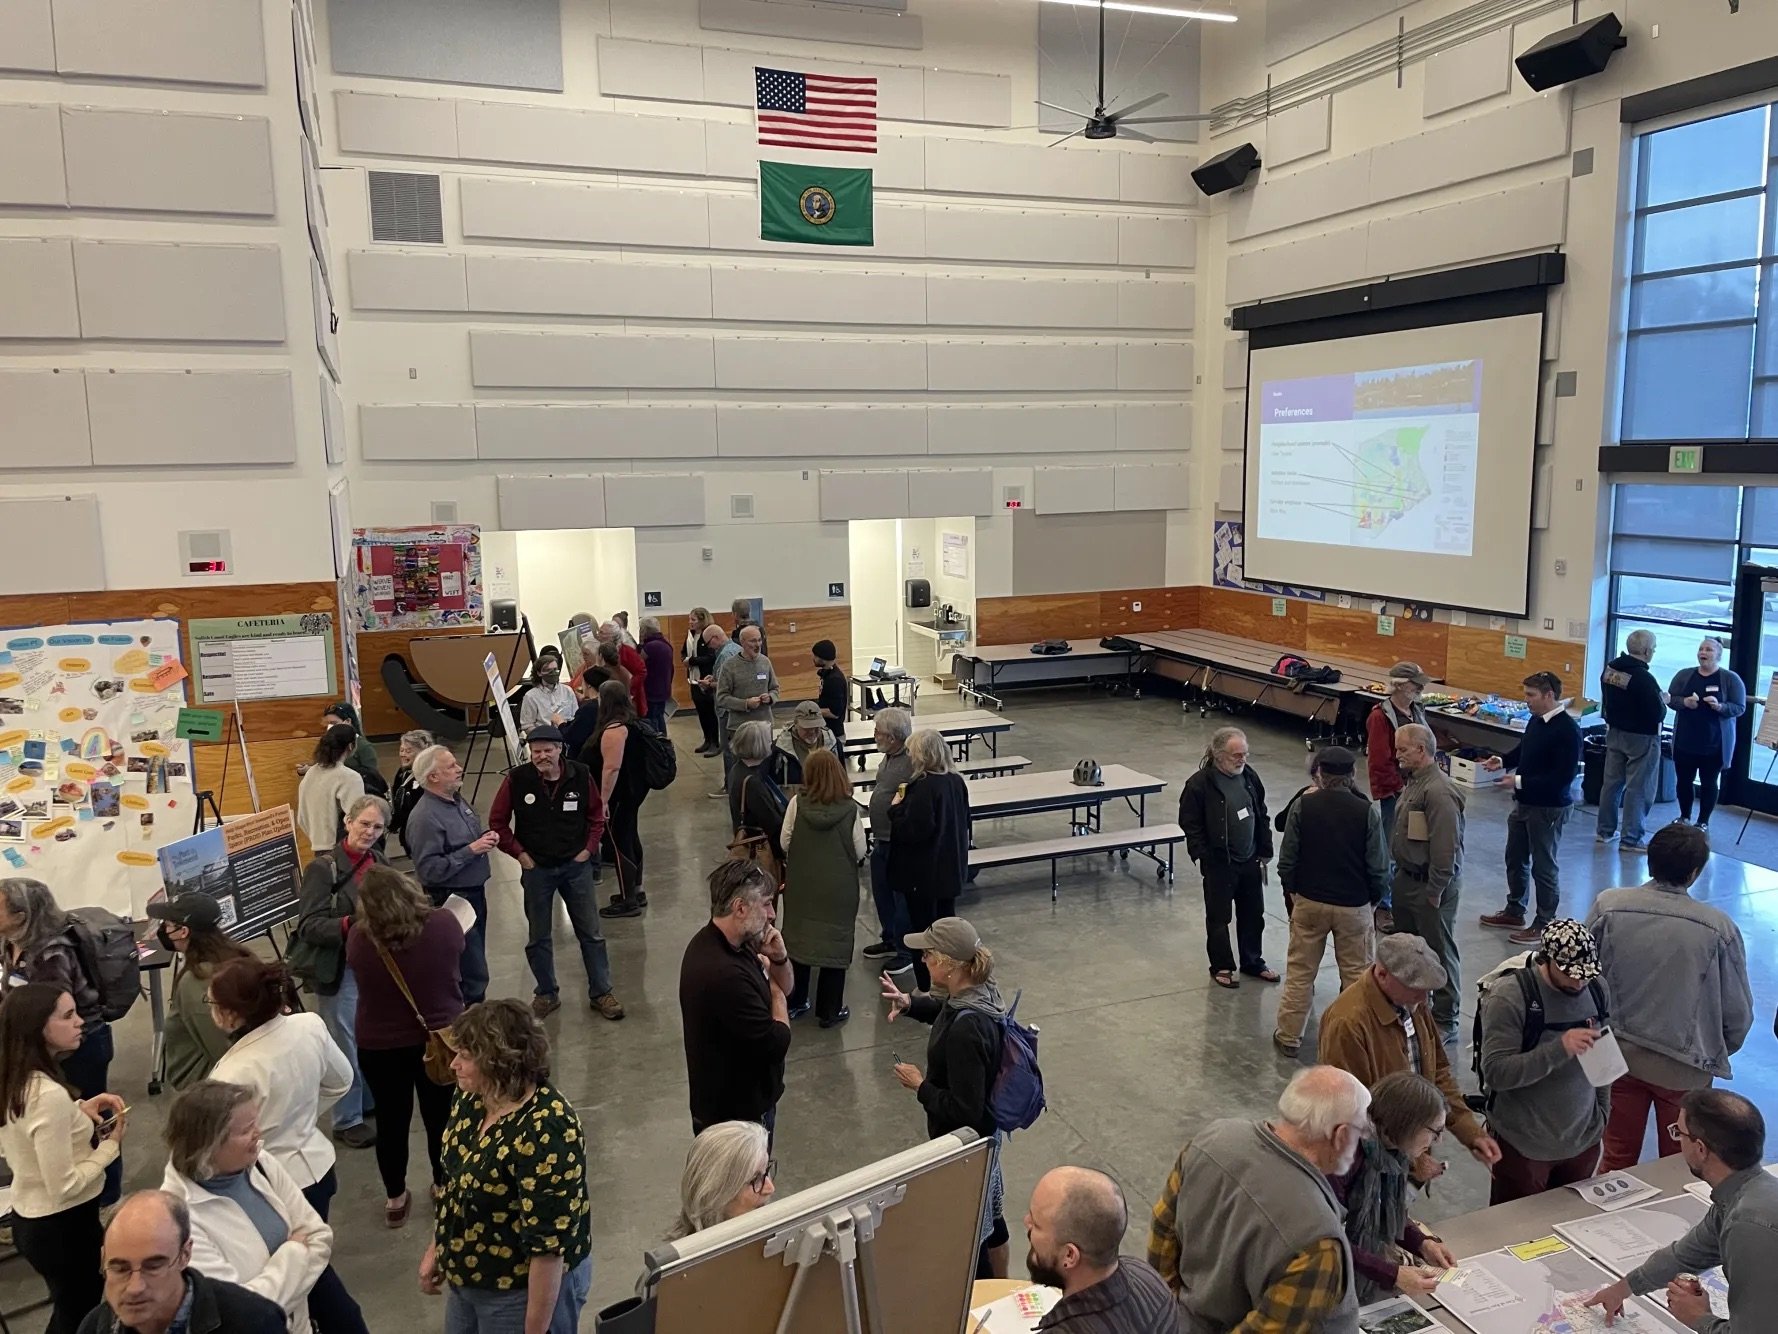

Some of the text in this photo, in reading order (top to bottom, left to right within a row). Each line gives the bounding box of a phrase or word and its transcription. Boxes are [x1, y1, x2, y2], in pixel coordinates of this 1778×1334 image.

[1274, 407, 1313, 417] Preferences
[1675, 450, 1695, 468] EXIT
[237, 619, 285, 628] CAFETERIA
